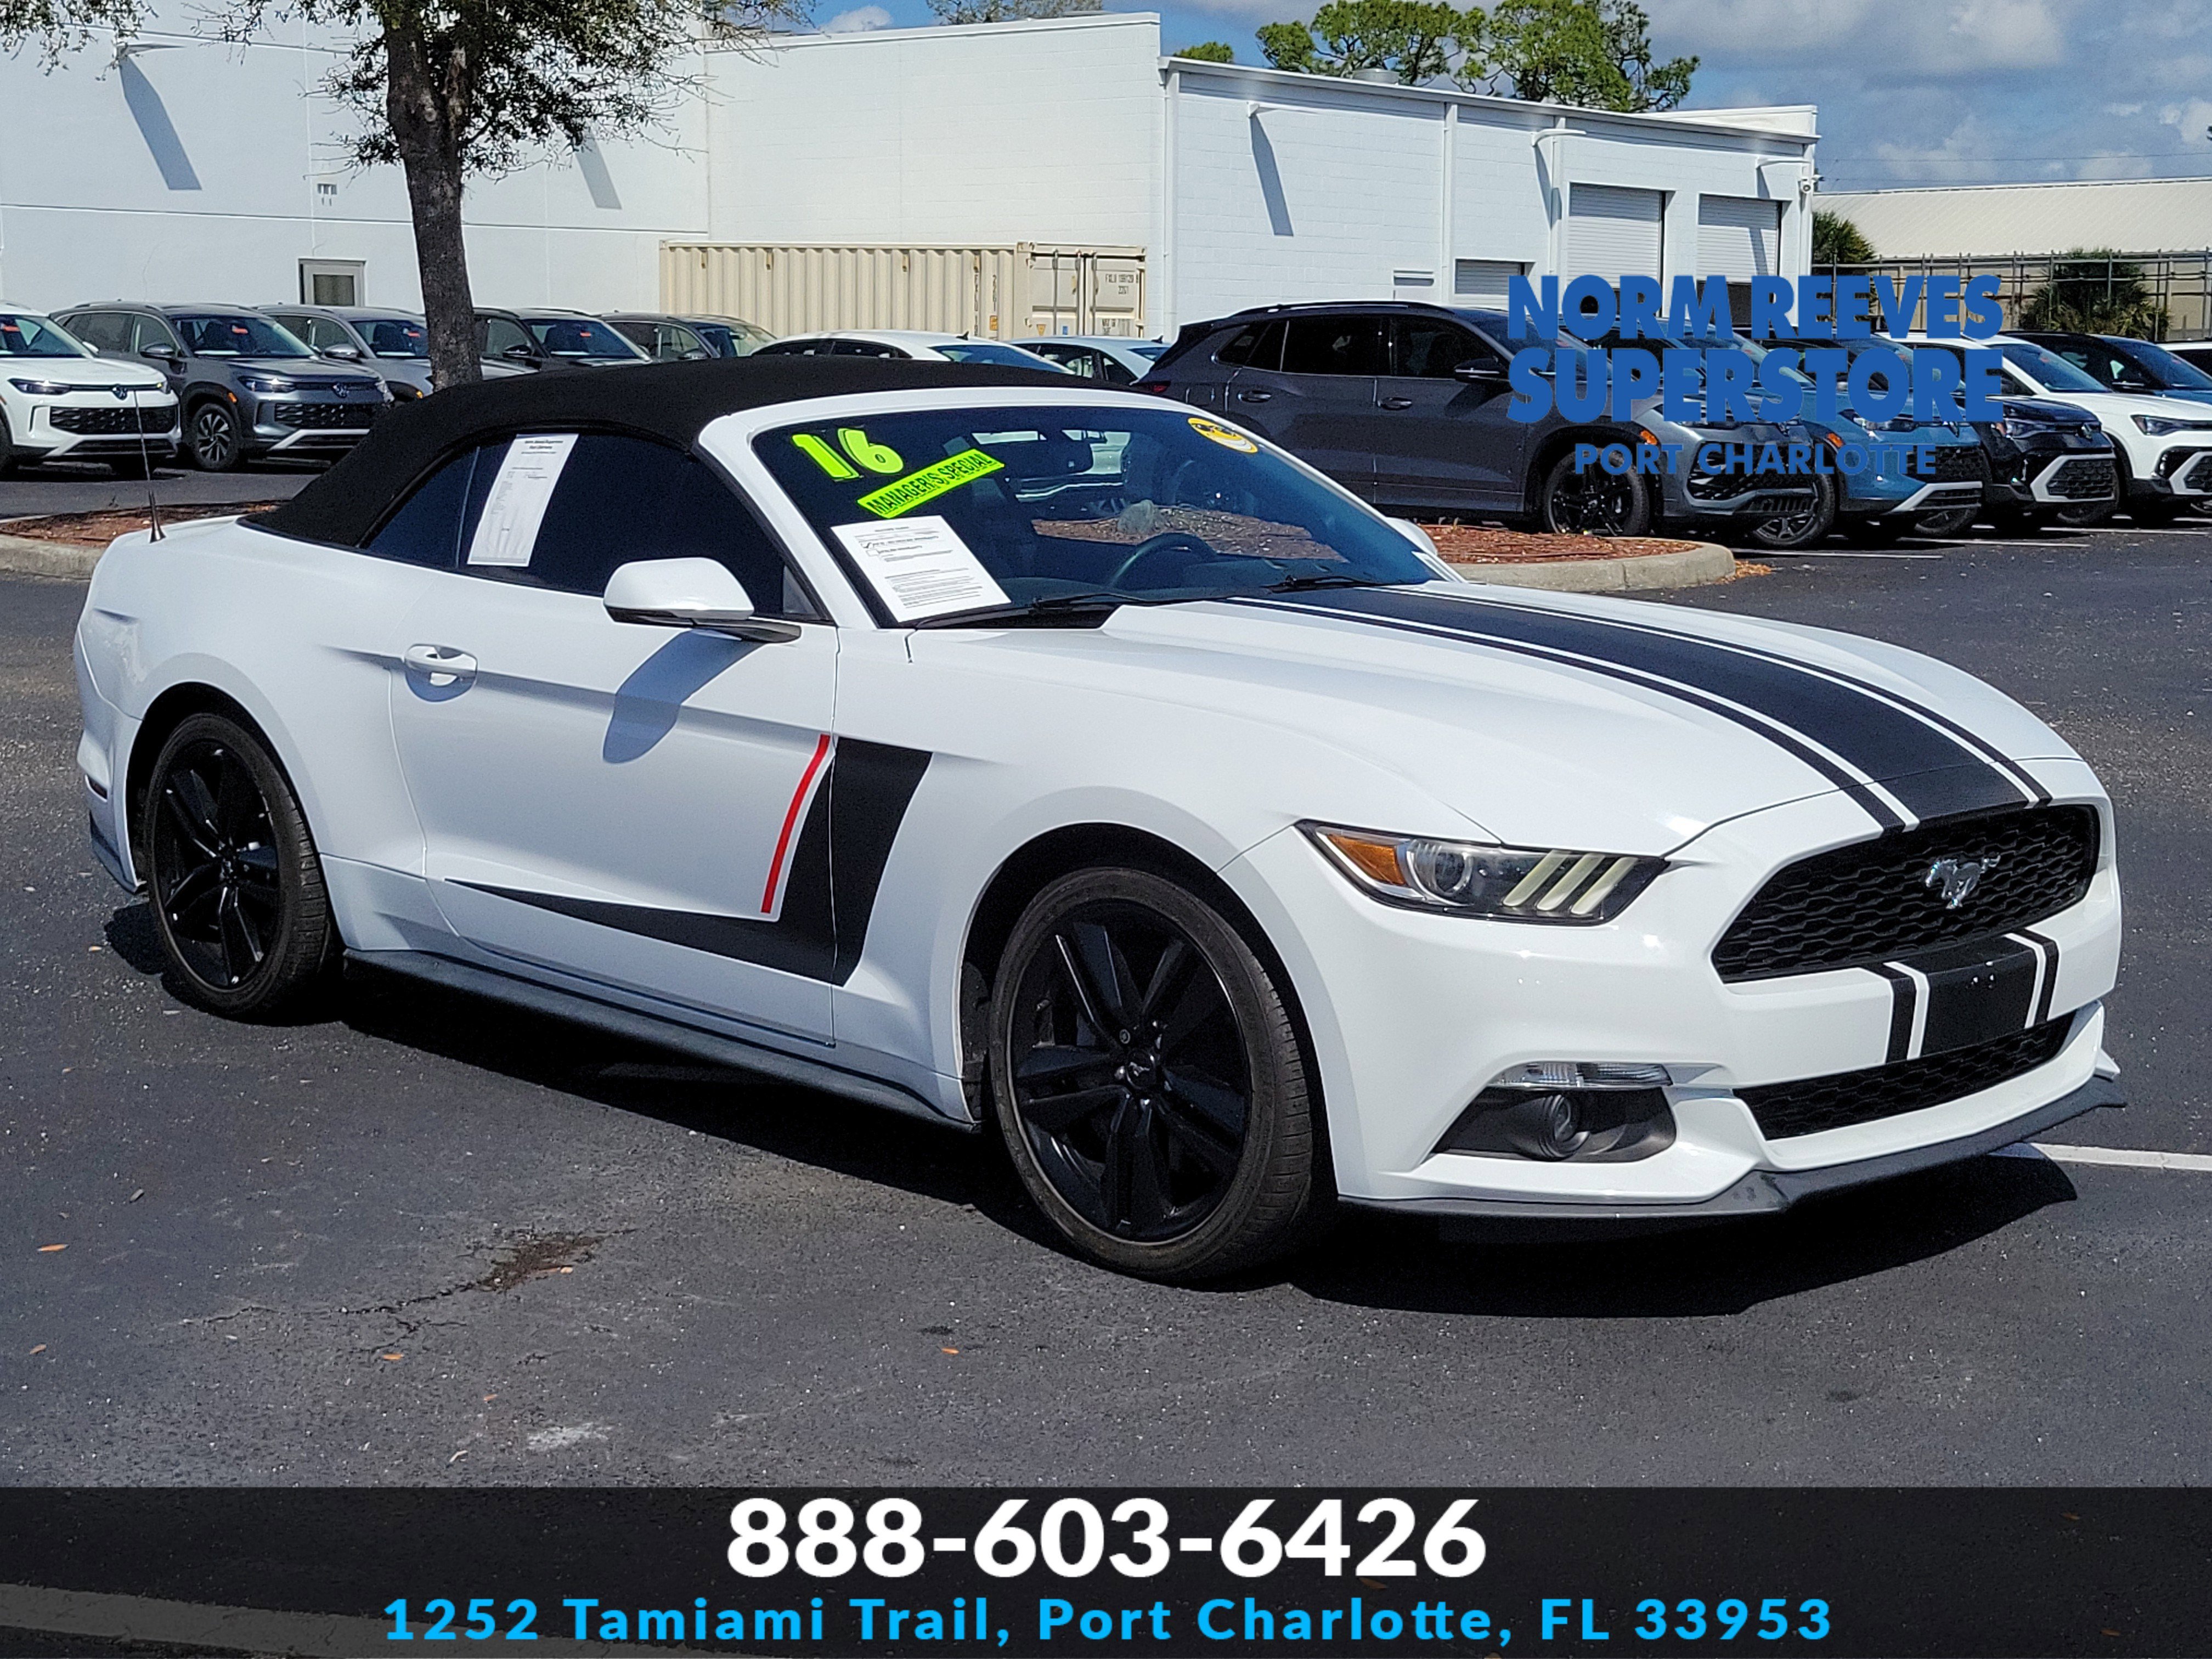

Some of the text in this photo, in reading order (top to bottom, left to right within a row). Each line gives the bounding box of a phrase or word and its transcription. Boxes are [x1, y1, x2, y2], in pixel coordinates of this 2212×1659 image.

[792, 428, 904, 479] 16
[866, 453, 993, 515] MANAGER'S SPECIAL
